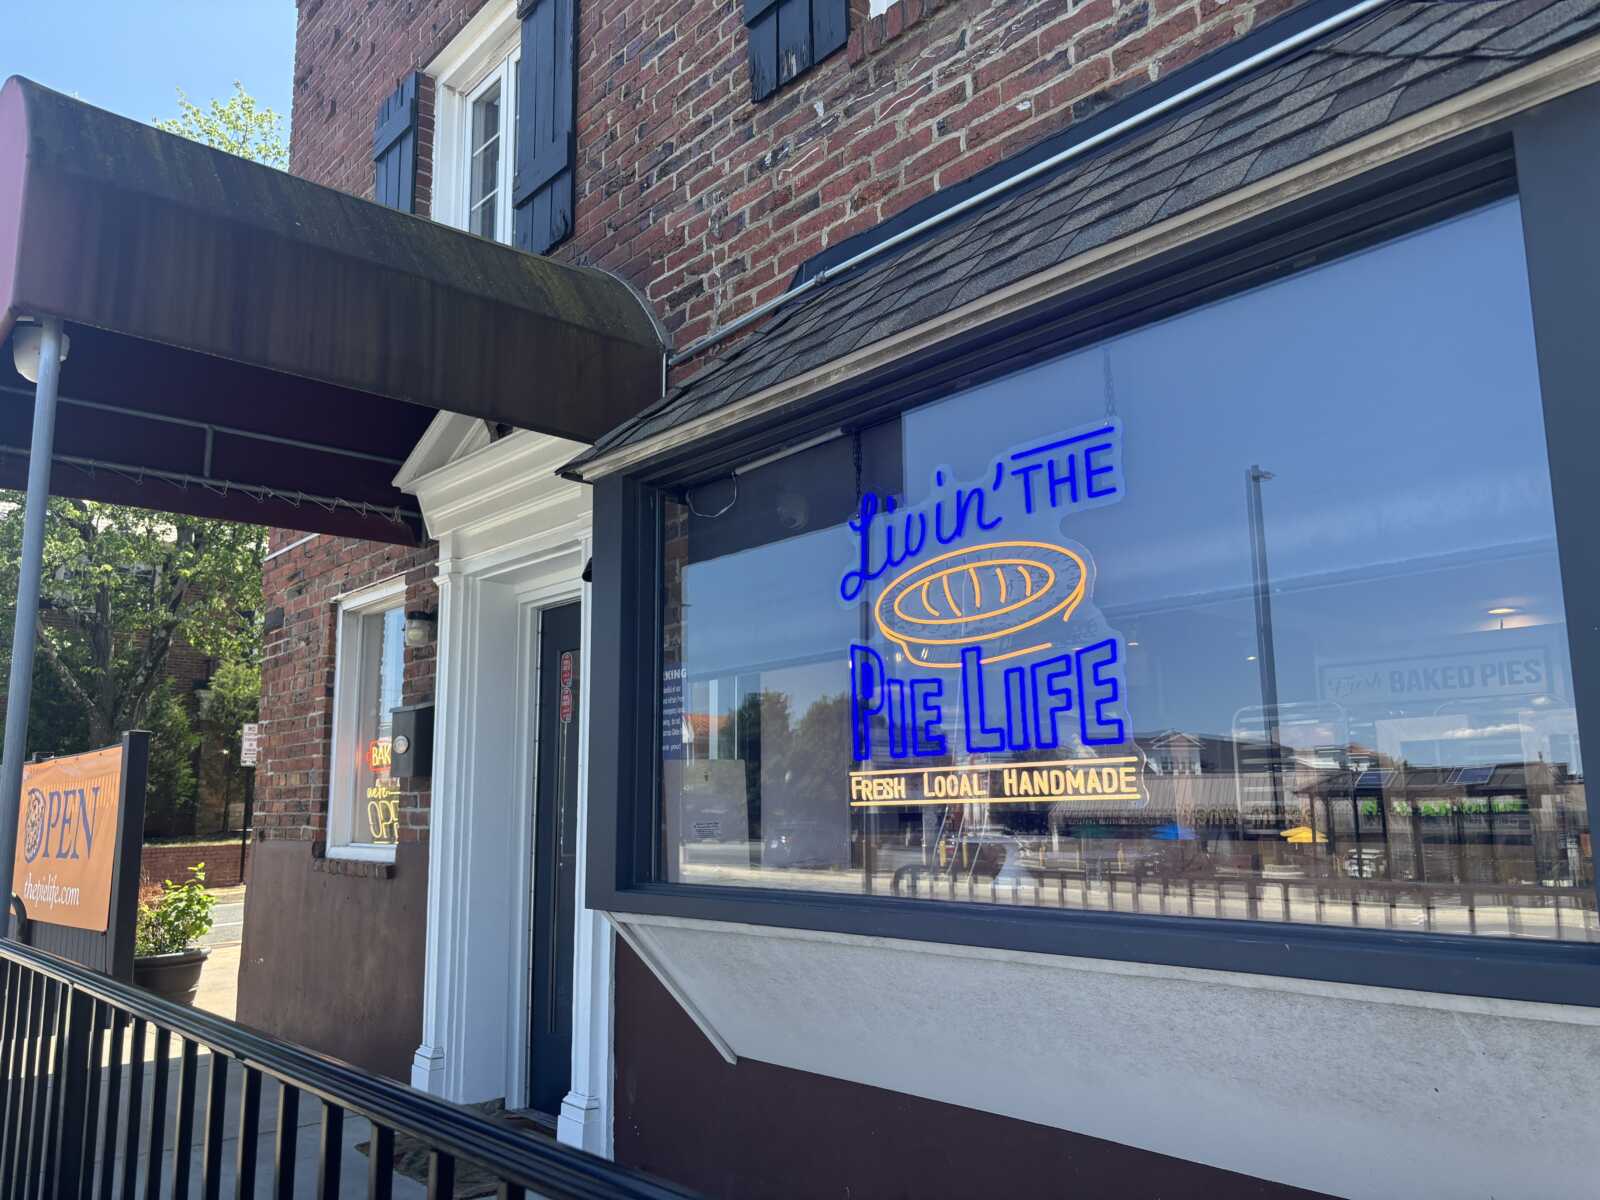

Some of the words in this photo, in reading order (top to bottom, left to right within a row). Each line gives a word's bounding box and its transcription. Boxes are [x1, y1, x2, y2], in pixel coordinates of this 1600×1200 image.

[840, 461, 1003, 602] Livin'
[1010, 442, 1118, 514] THE
[850, 644, 947, 761] PIE
[960, 637, 1125, 753] LIFE
[1389, 664, 1474, 693] BAKED
[1481, 657, 1541, 687] PIES
[850, 776, 907, 801] FRESH
[922, 772, 987, 798] LOCAL
[1002, 767, 1138, 797] HANDMADE
[24, 786, 100, 864] OPEN
[24, 872, 80, 910] thepielife.com
